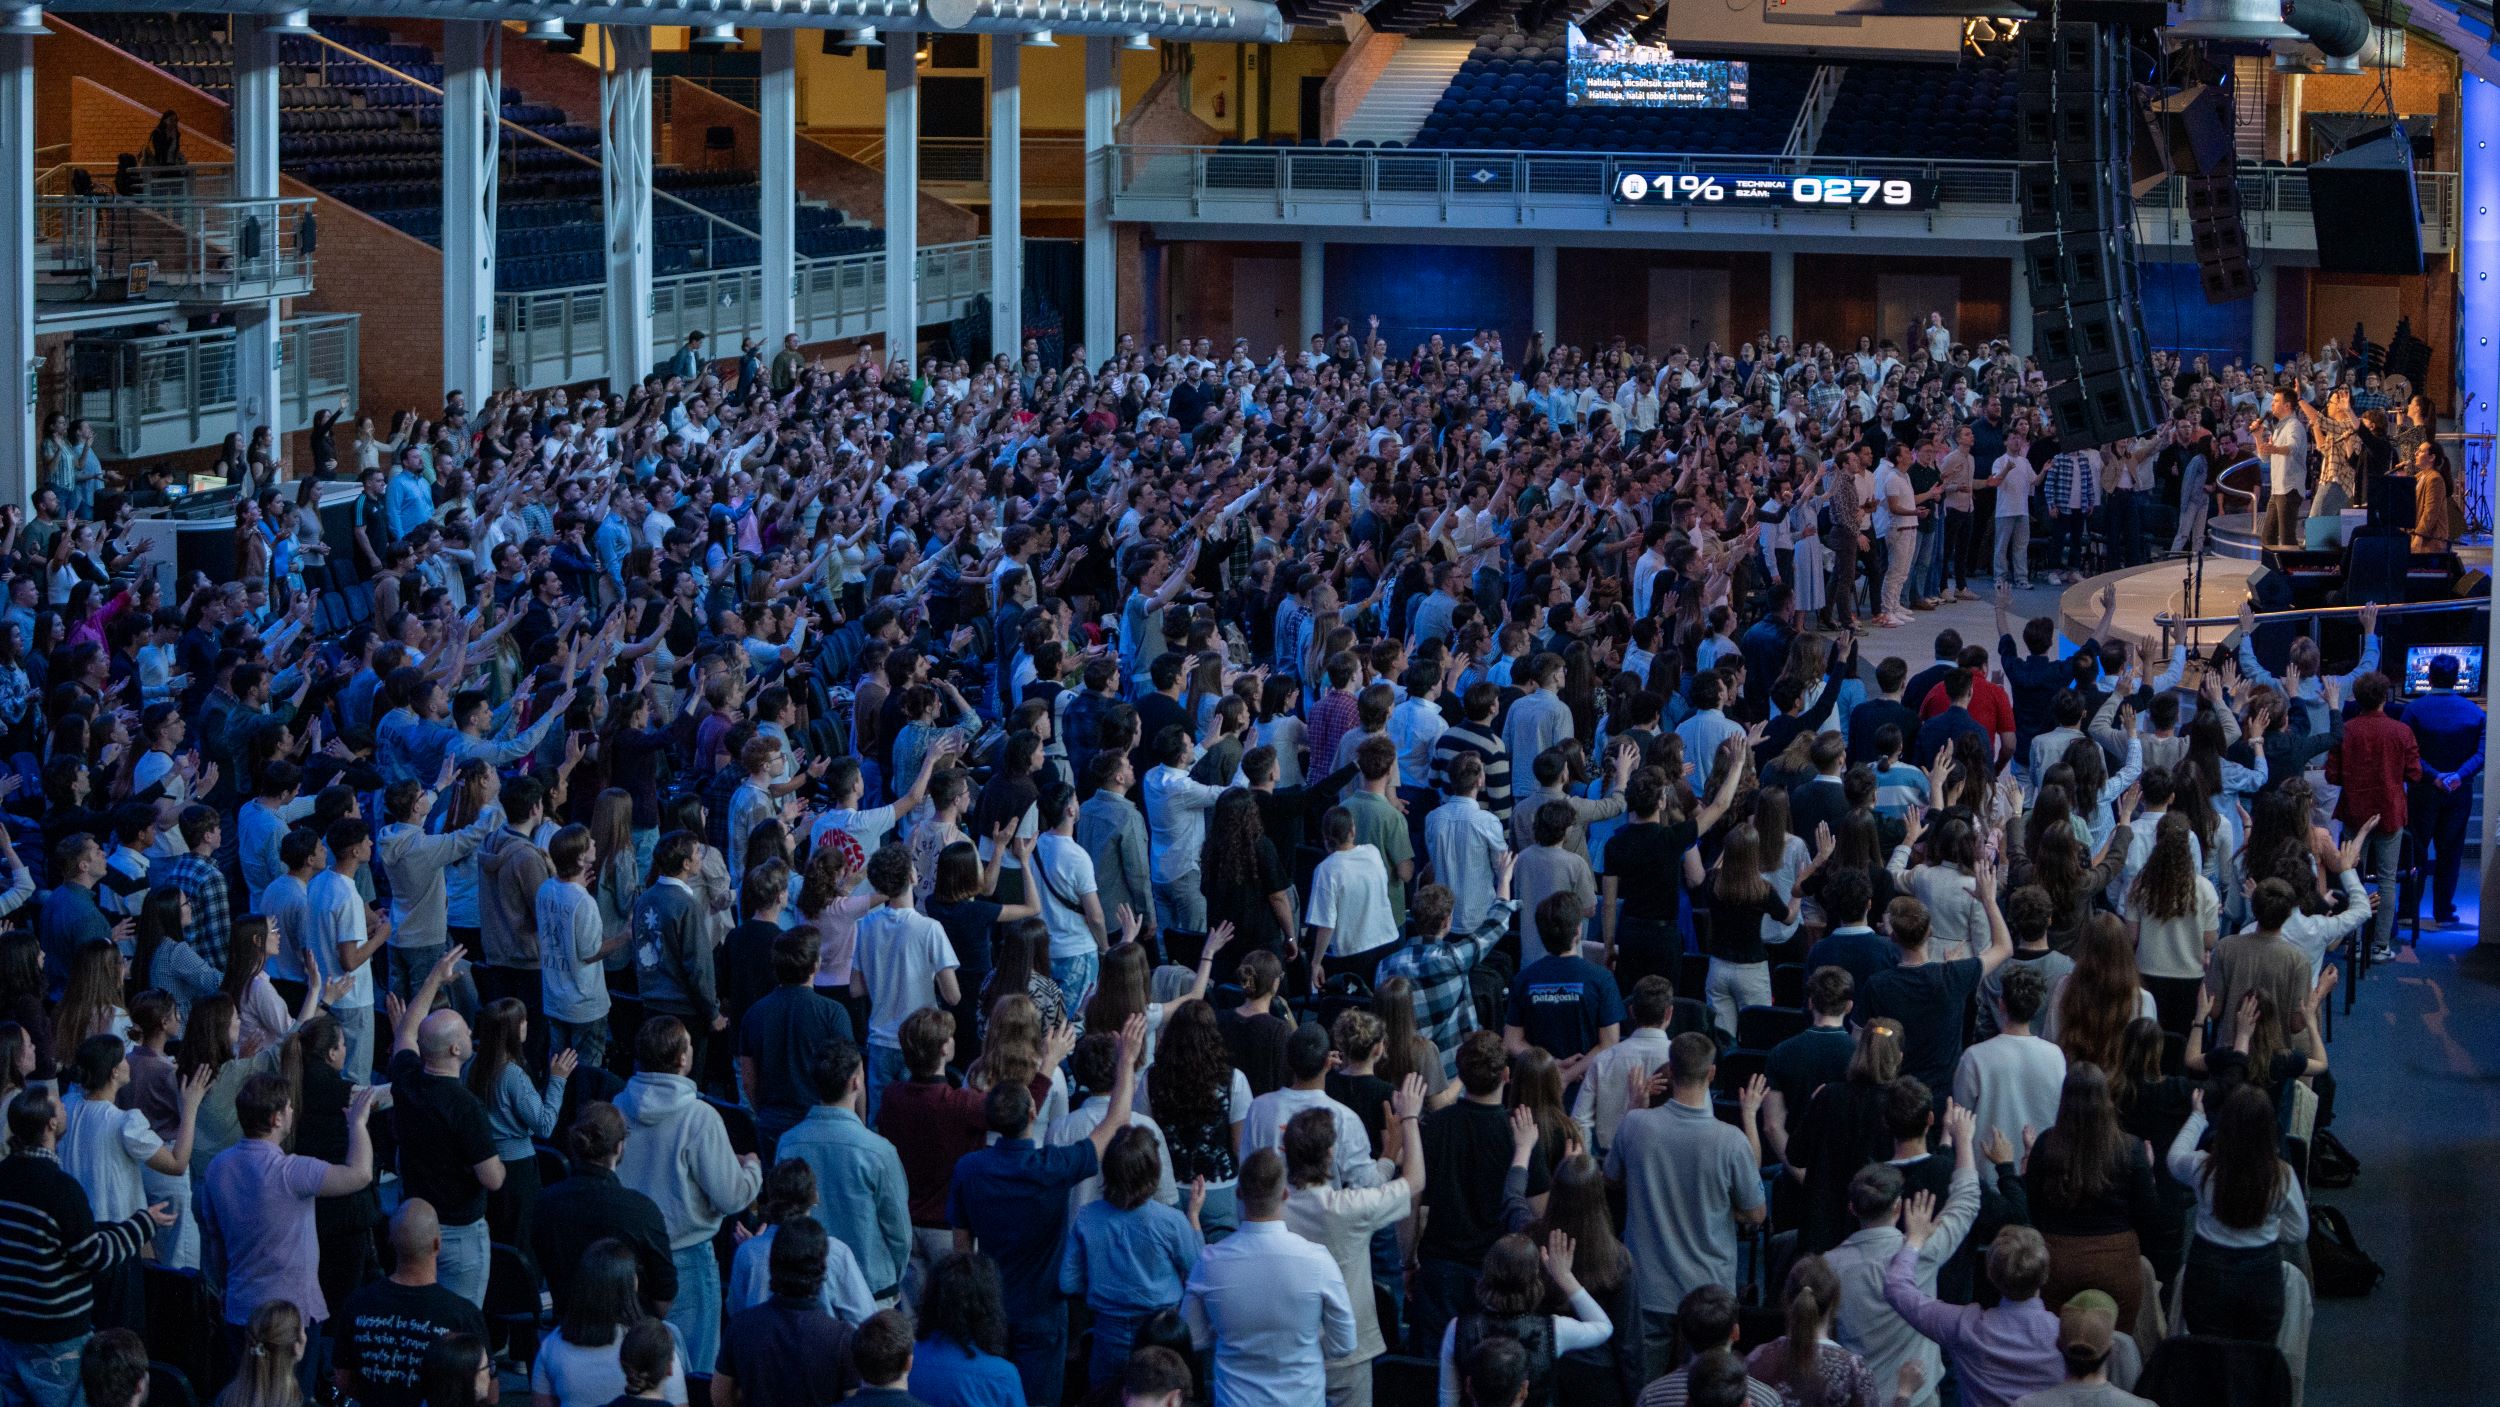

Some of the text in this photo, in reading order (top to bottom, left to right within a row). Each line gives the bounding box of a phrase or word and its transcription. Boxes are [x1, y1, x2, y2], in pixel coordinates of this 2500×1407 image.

[1587, 78, 1623, 88] Halleluja,
[1685, 79, 1707, 88] Nevét
[1589, 91, 1624, 101] Halleluja,
[1626, 91, 1645, 100] halál
[1646, 91, 1667, 100] többé
[1669, 92, 1677, 100] el
[1696, 92, 1705, 101] ér
[1653, 175, 1911, 204] 1% 0279
[1736, 188, 1770, 197] SZÁM:
[1532, 993, 1580, 1004] patagonia
